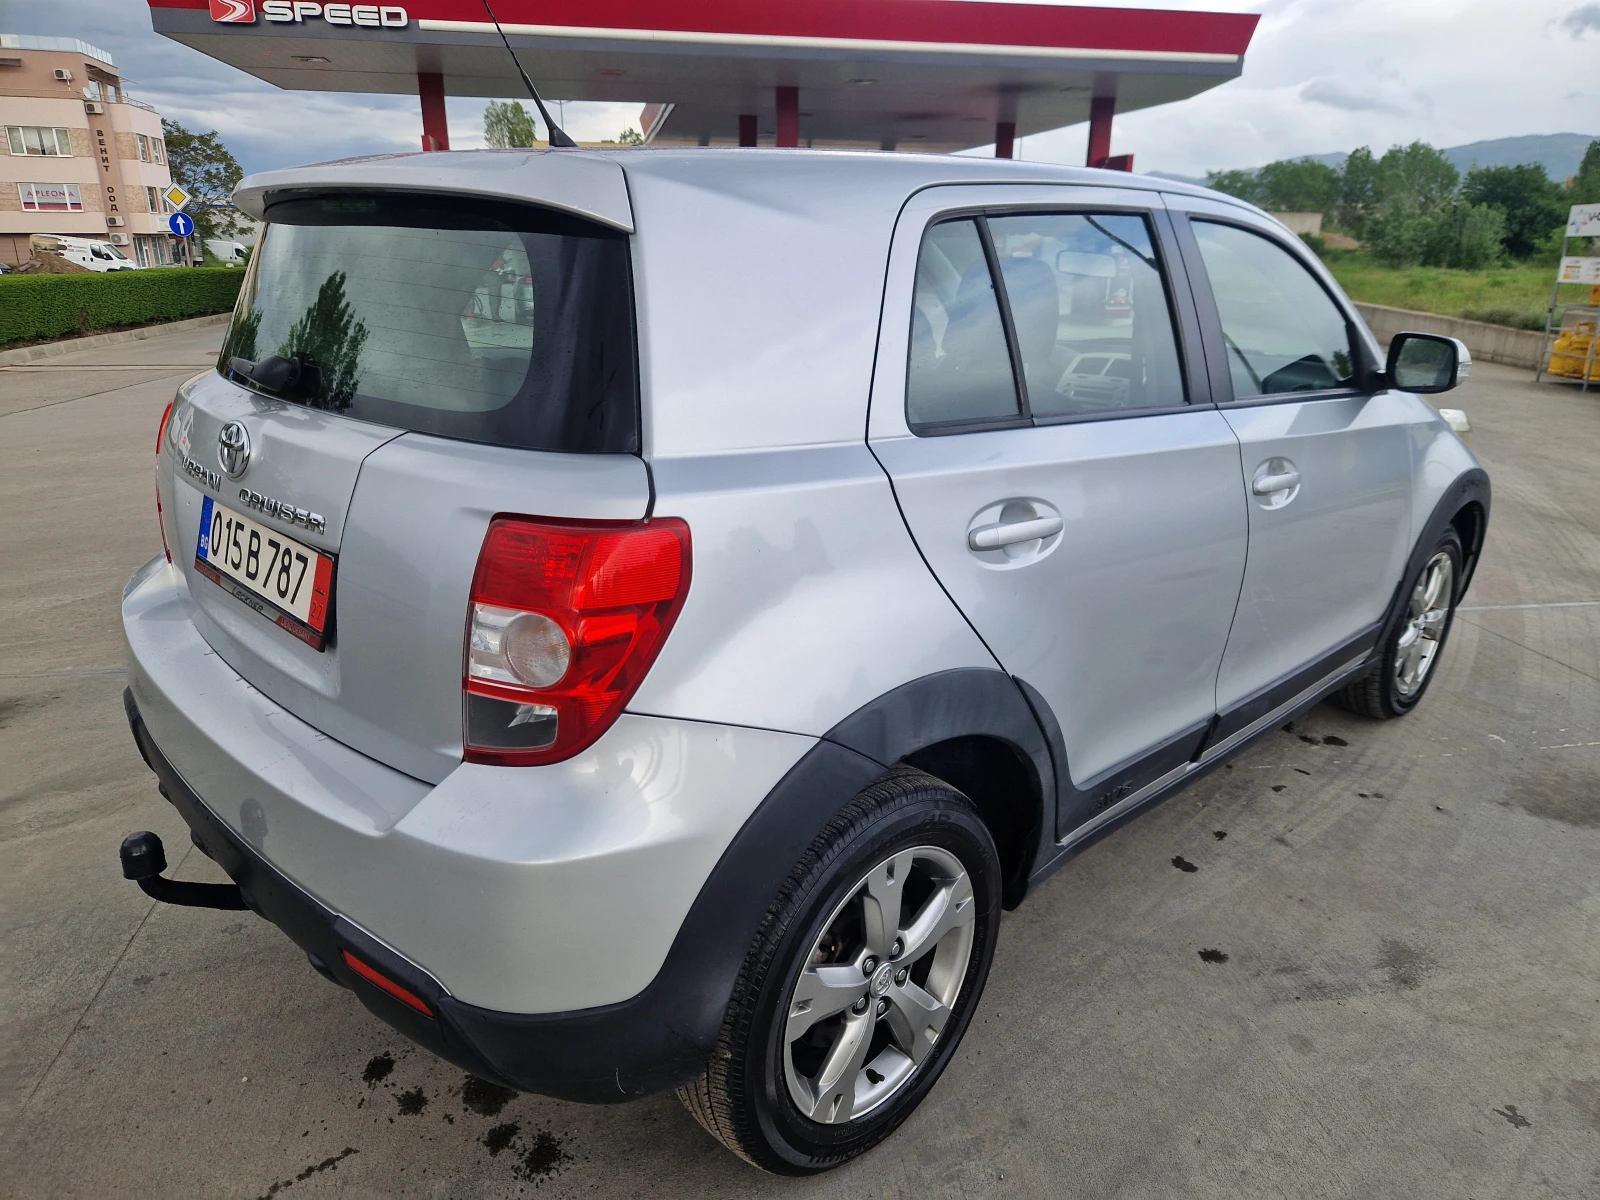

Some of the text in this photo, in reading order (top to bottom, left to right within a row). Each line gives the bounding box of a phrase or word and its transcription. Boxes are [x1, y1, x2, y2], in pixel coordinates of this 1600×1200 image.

[263, 0, 408, 27] SPEED
[96, 129, 119, 212] ВЕНИТ ООД
[238, 488, 328, 535] CRUISER
[200, 533, 209, 550] BG
